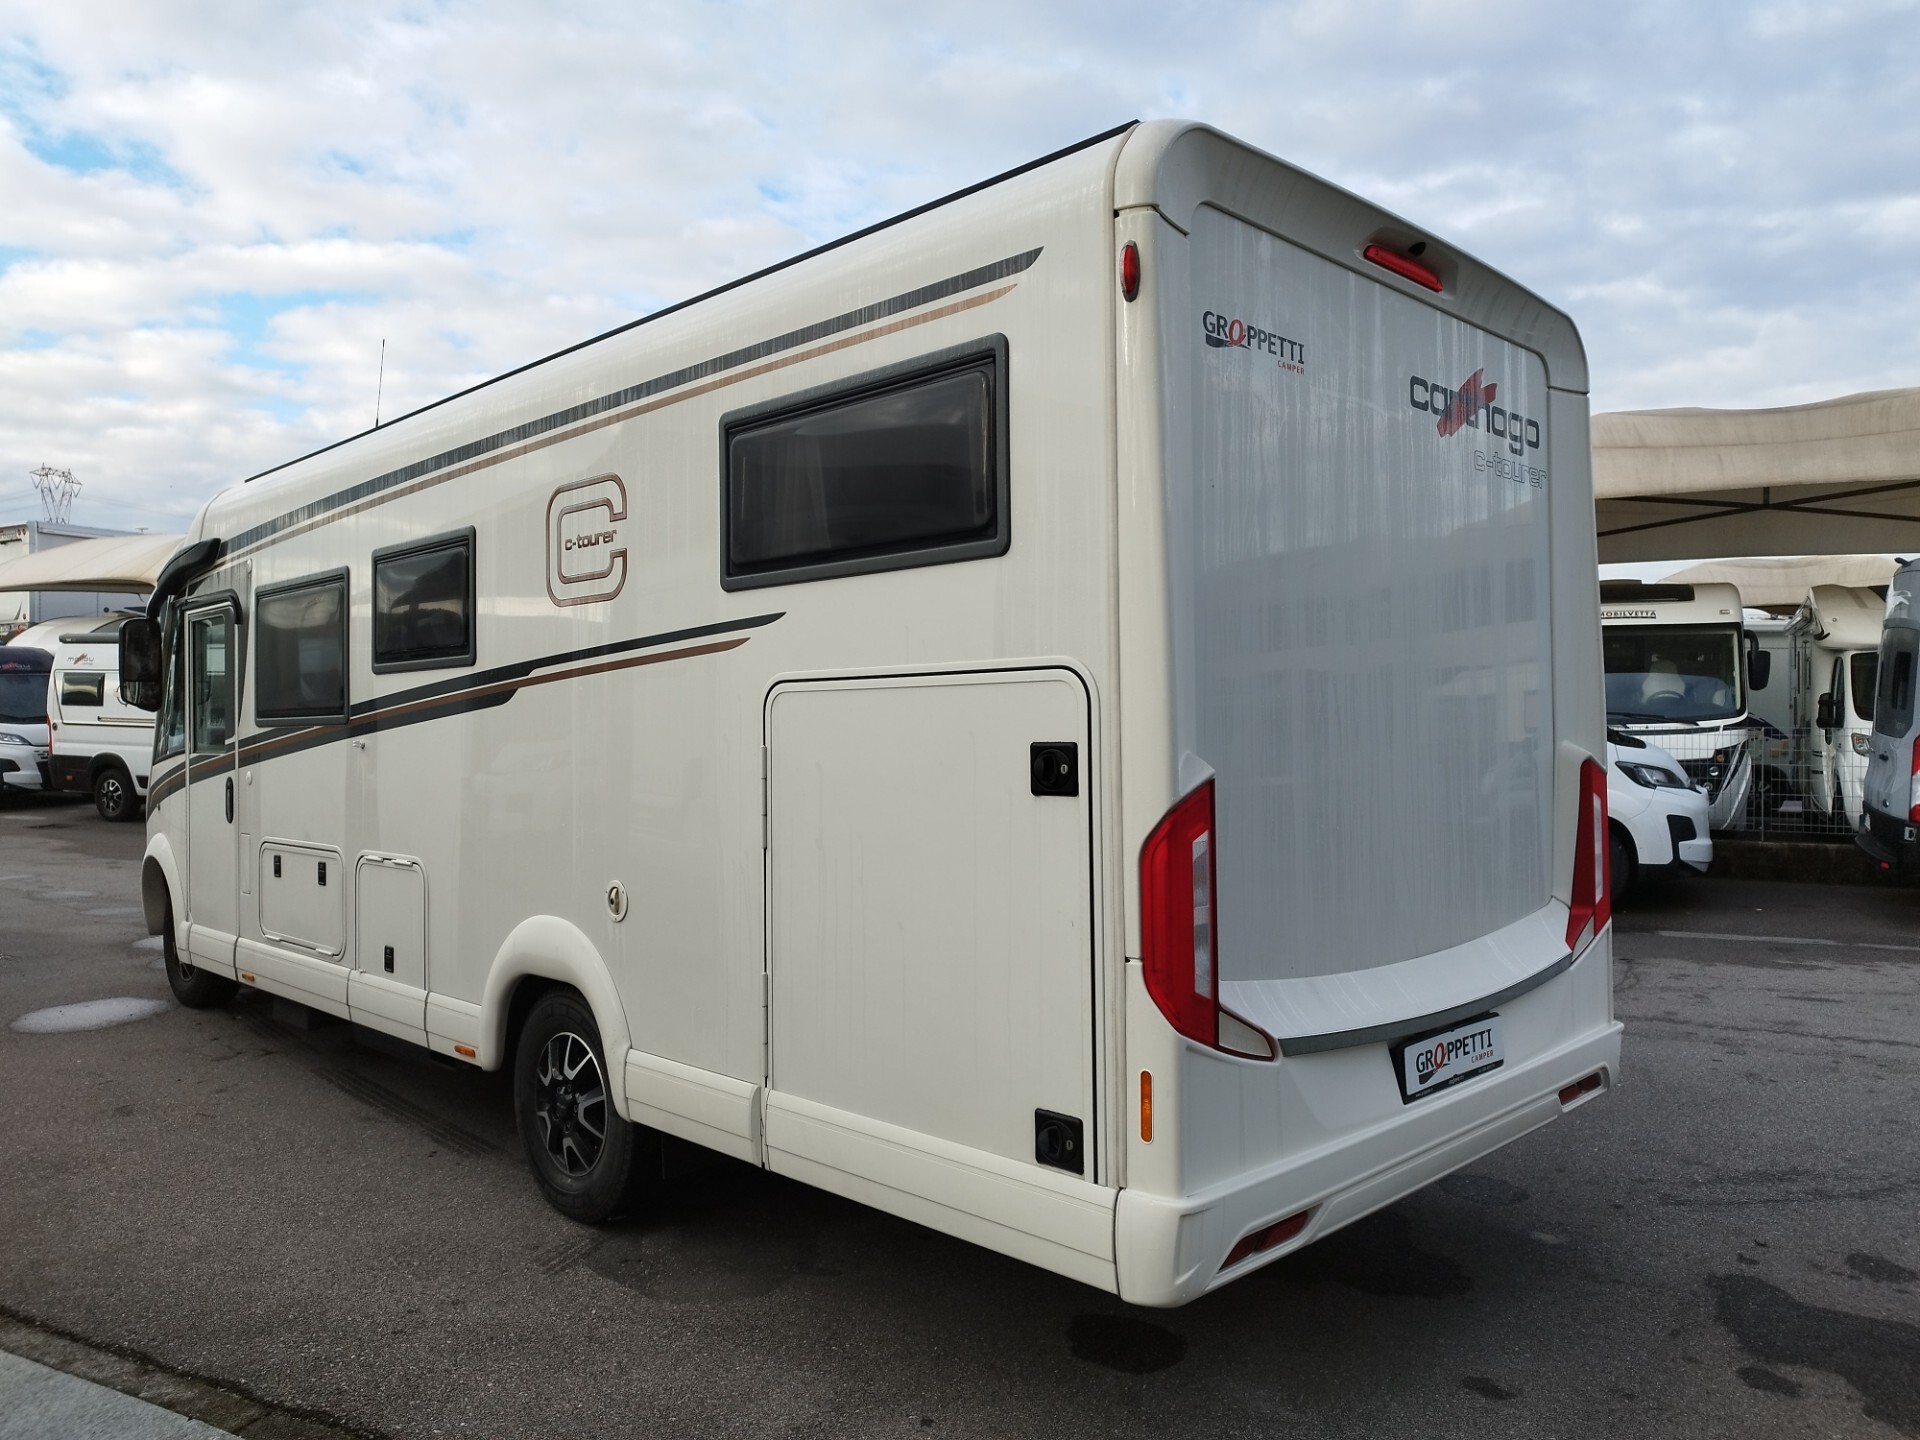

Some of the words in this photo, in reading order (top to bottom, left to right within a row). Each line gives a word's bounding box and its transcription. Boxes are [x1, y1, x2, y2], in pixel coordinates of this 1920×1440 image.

[1202, 310, 1305, 364] GROPPETTI
[1277, 360, 1305, 375] CAMPER
[1409, 375, 1540, 457] carthago
[1473, 449, 1547, 489] c-tourer
[564, 529, 617, 551] c-tourer
[1416, 1028, 1493, 1074] GROPPETTI
[1471, 1049, 1494, 1064] CAMPER
